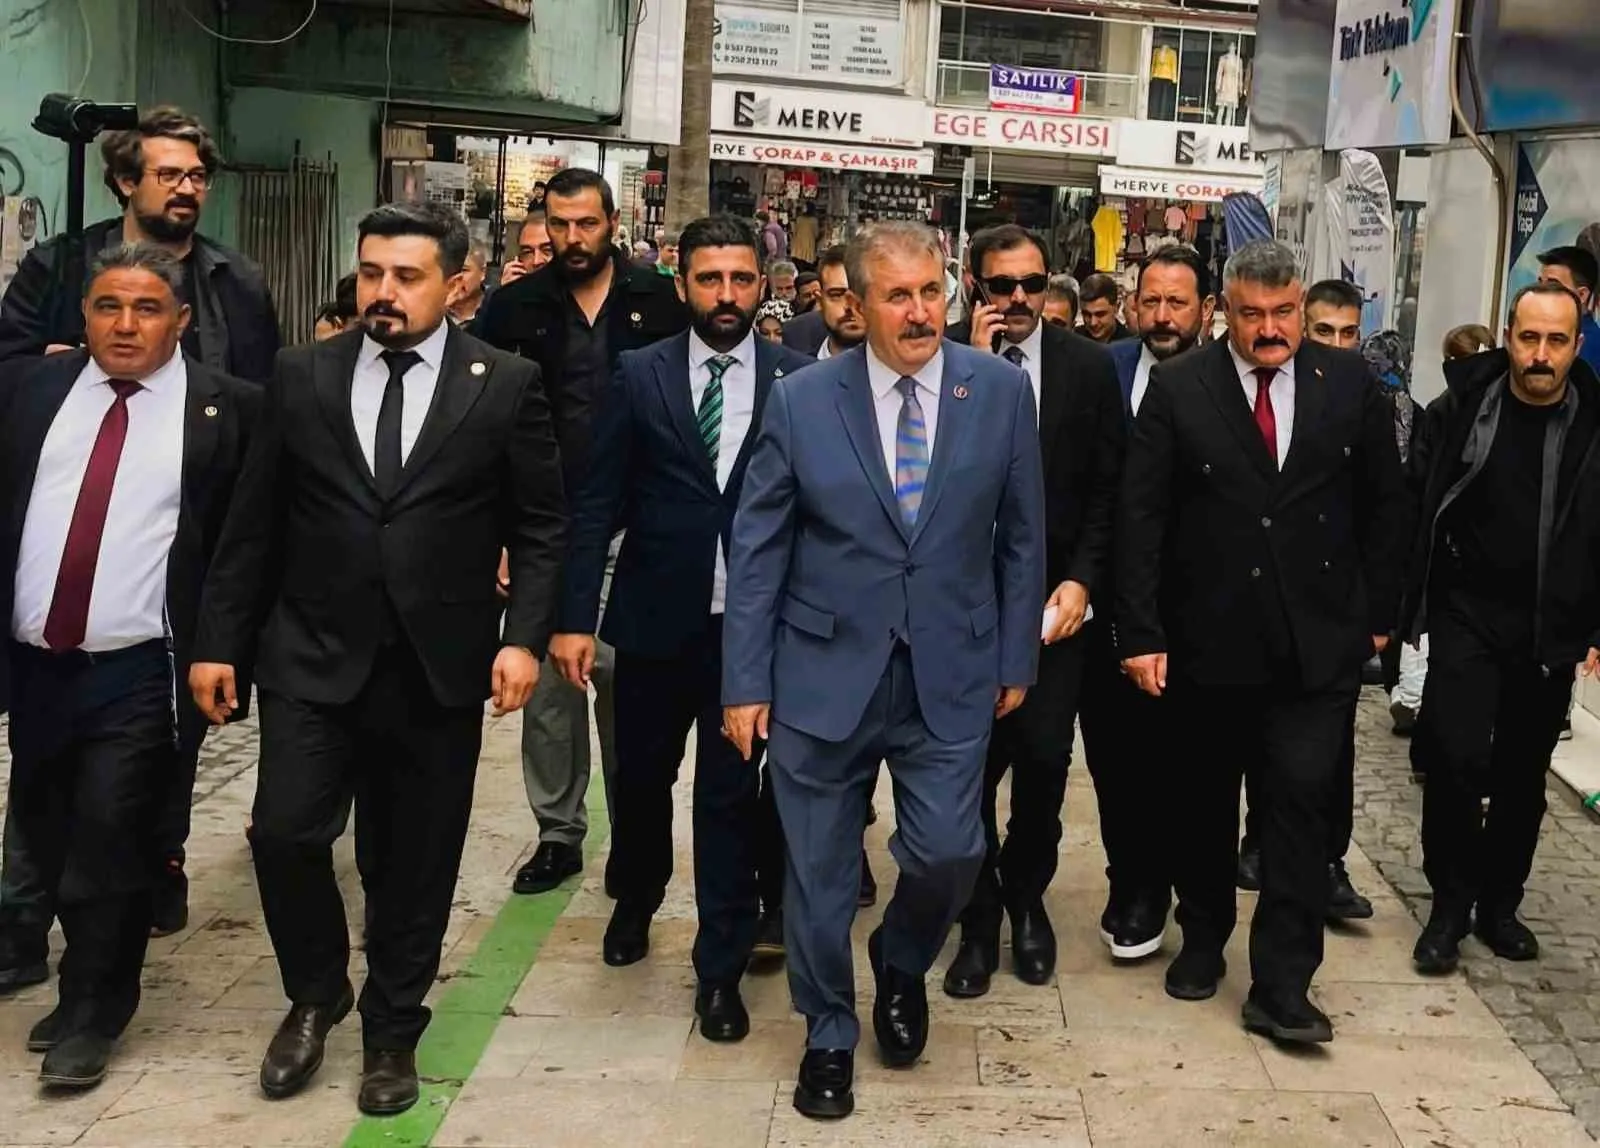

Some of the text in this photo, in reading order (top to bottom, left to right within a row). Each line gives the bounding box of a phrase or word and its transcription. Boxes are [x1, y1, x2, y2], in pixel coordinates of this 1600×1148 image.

[1363, 11, 1409, 55] Telekom
[998, 70, 1068, 90] SATILIK
[778, 107, 862, 133] MERVE
[934, 113, 1109, 149] EGE ÇARŞISI
[713, 143, 919, 171] RVE ÇORAP & ÇAMAŞIR
[1216, 142, 1268, 164] MER
[1113, 179, 1169, 193] MERVE
